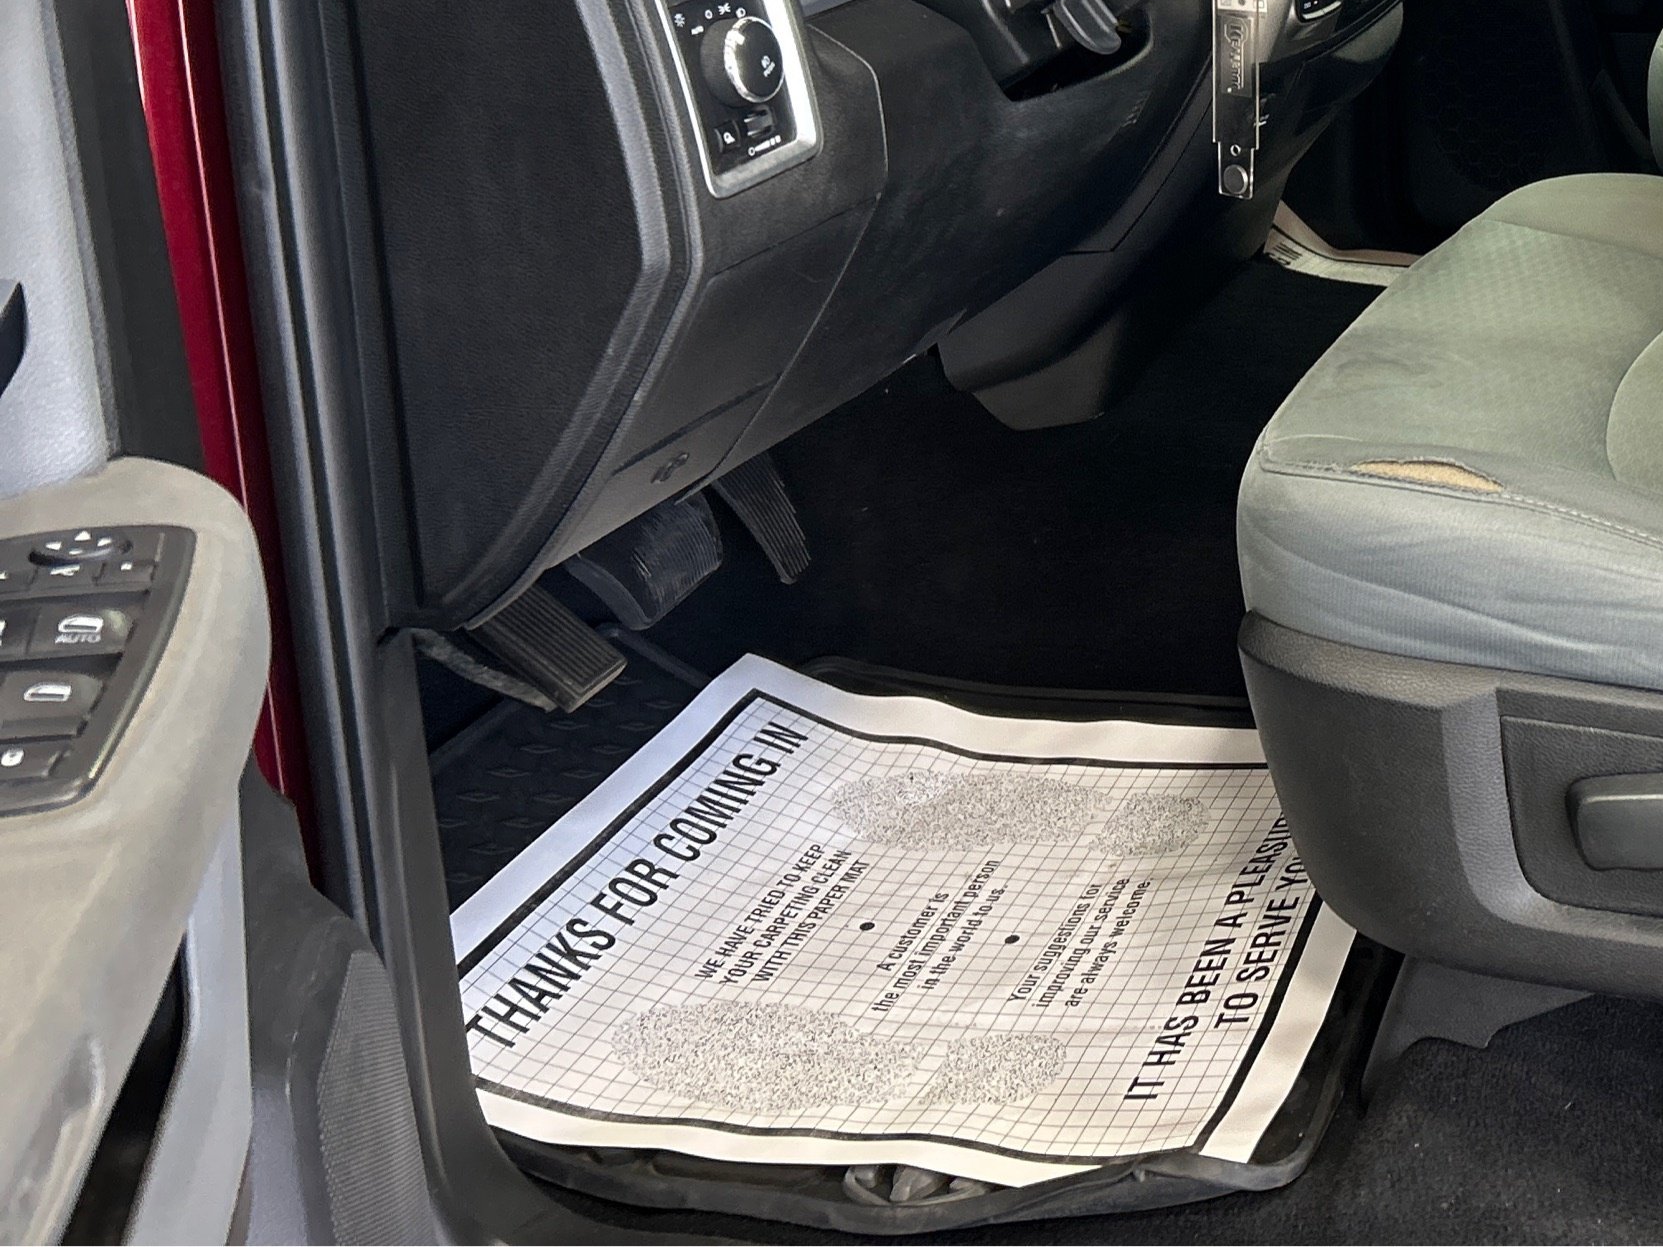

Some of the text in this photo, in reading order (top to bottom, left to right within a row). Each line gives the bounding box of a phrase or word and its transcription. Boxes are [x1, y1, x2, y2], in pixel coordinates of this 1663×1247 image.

[55, 633, 101, 644] AUTO
[465, 721, 809, 1048] THANKS FOR COMING IN
[694, 844, 825, 979] WE HAVE TRIED TO KEEP
[719, 850, 852, 984] YOUR CARPETING CLEAN
[752, 860, 870, 982] WITH THIS PAPER MAT
[871, 860, 1001, 1012] the most important person
[876, 892, 950, 971] A customer is
[917, 884, 1008, 990] in the world to us.
[1007, 884, 1102, 1001] Your suggestions for
[1031, 878, 1130, 1008] improving our service
[1065, 877, 1154, 1007] are always welcome.
[1213, 912, 1248, 928] A
[1213, 856, 1308, 1029] TO SERVE YO
[1175, 936, 1236, 1006] BEEN
[1123, 1076, 1165, 1100] IT
[1142, 1015, 1199, 1067] HAS
